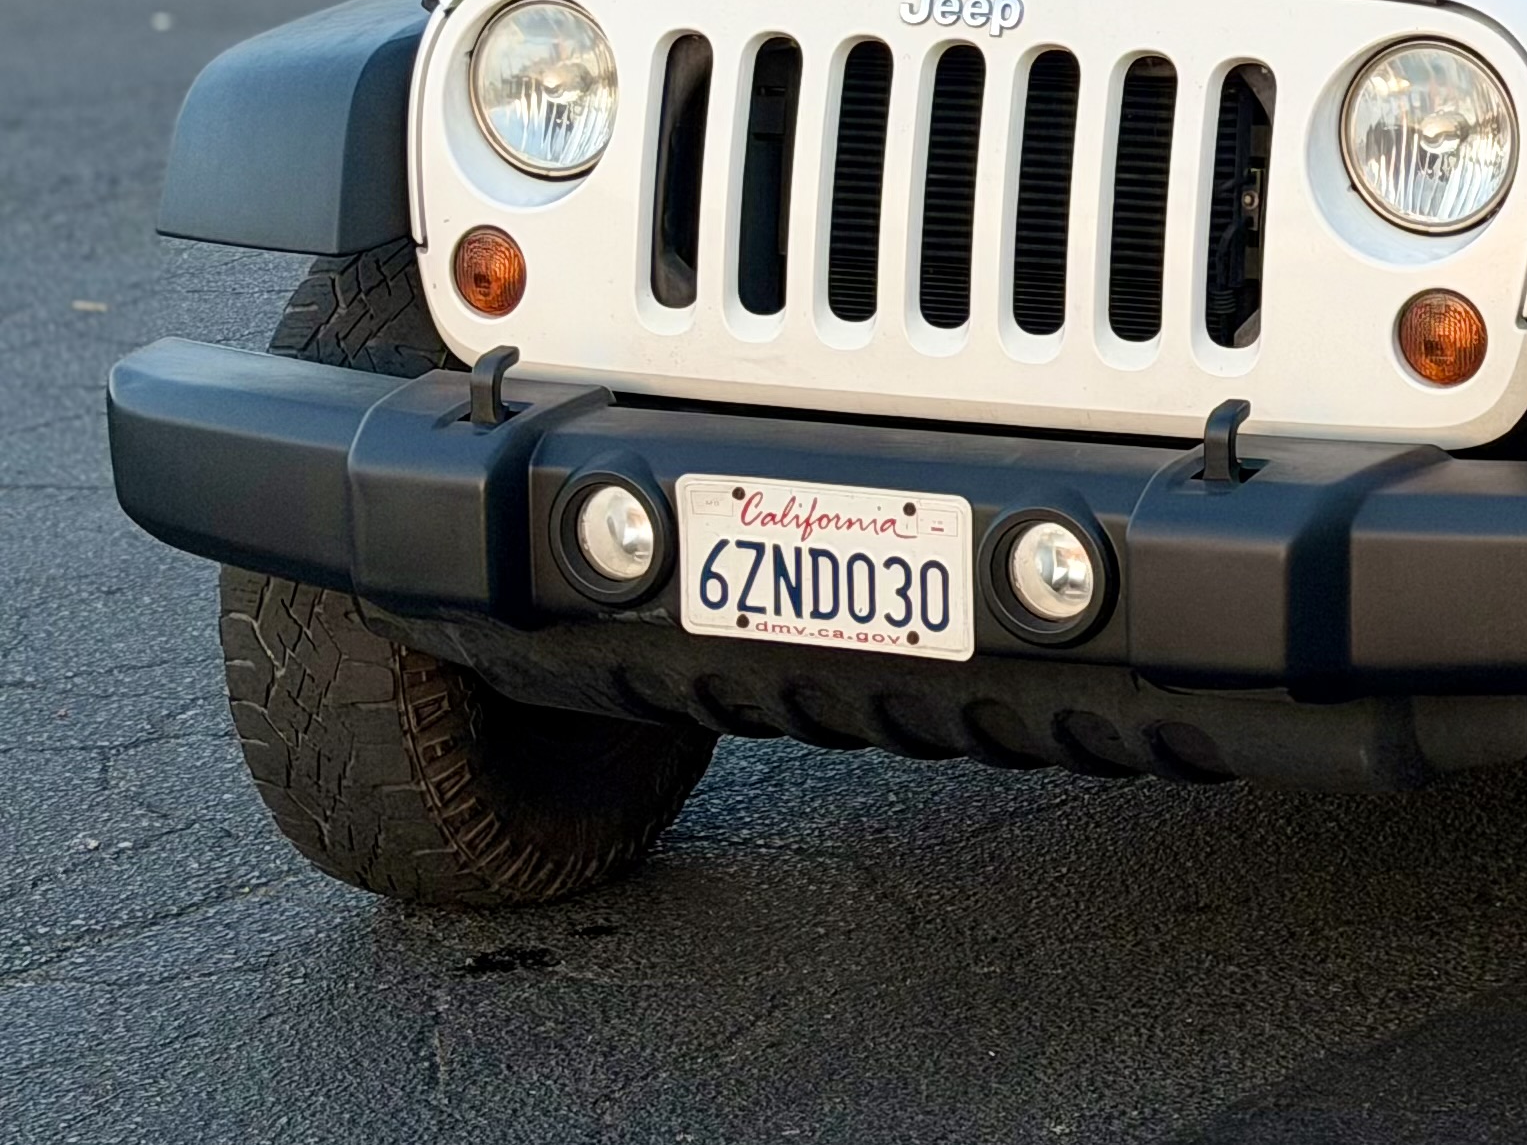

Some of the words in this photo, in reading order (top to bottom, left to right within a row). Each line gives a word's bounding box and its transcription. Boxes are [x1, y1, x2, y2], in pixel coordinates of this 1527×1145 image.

[740, 491, 918, 542] California
[700, 538, 950, 633] 6ZND030
[755, 620, 901, 645] dmv.ca.gov
